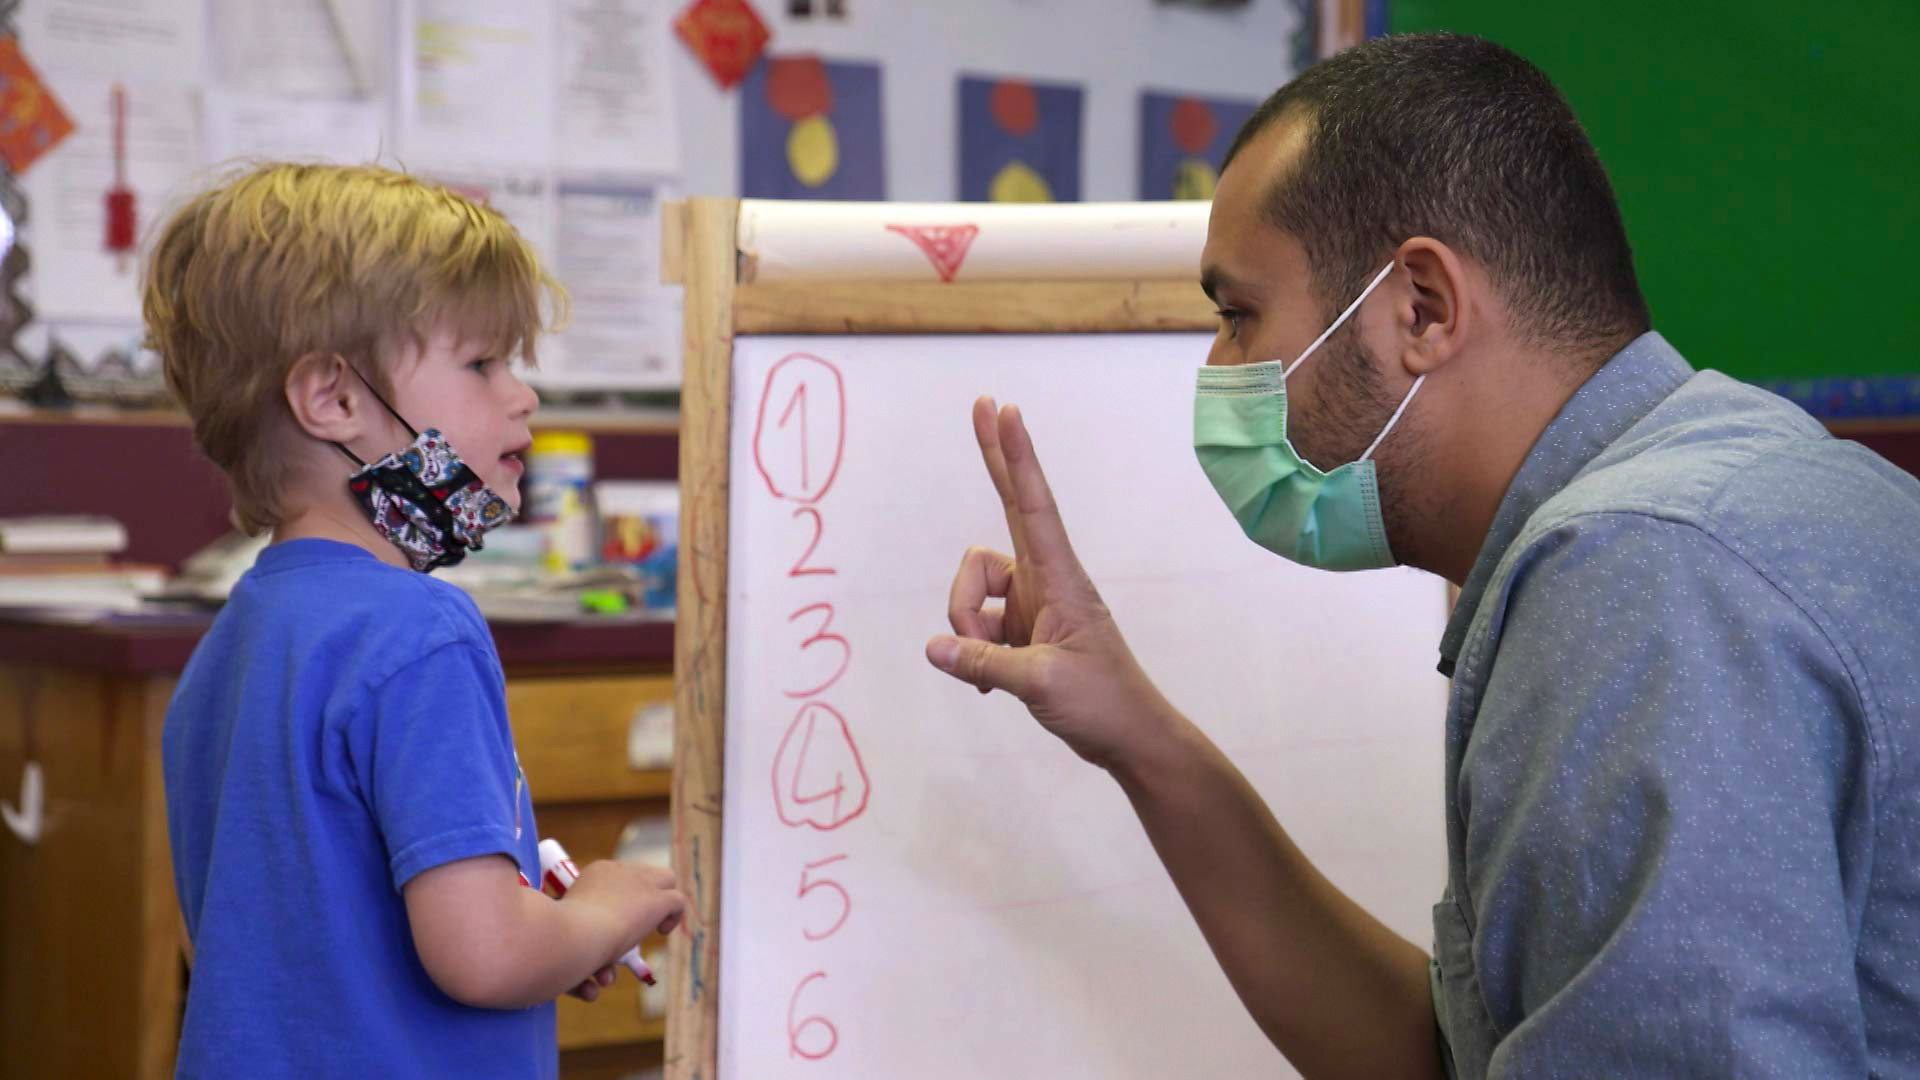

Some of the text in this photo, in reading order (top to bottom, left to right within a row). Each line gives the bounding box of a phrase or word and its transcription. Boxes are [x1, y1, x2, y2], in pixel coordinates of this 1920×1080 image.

[778, 383, 807, 491] 1
[788, 506, 836, 577] 2
[783, 603, 850, 698] 3
[791, 711, 846, 822] 4
[797, 853, 850, 941] 5
[787, 970, 838, 1059] 6
